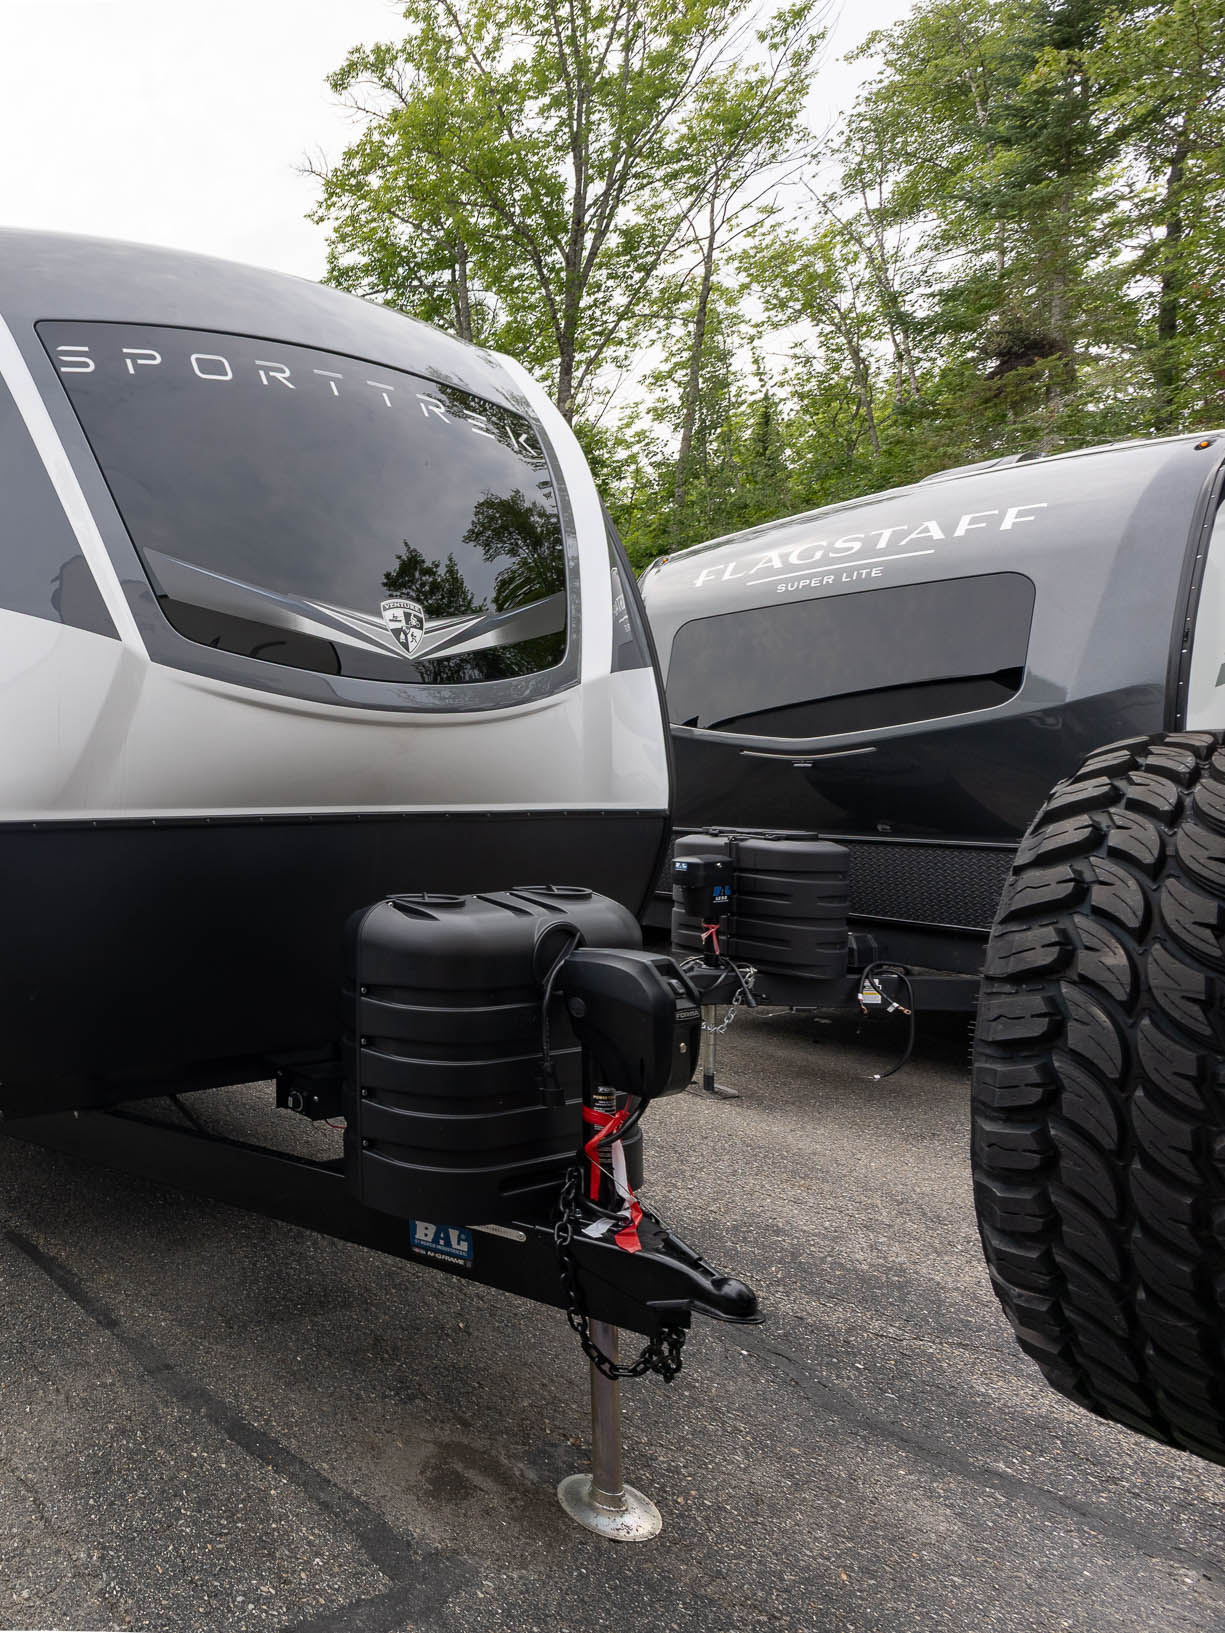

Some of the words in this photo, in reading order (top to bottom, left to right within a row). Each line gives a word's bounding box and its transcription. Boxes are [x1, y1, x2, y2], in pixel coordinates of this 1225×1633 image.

[55, 345, 537, 457] SPORTTREK
[694, 503, 1048, 587] FLAGSTAFF
[776, 574, 835, 593] SUPER
[842, 566, 884, 582] LITE
[384, 602, 421, 613] VENTURE
[415, 1220, 469, 1252] BAL
